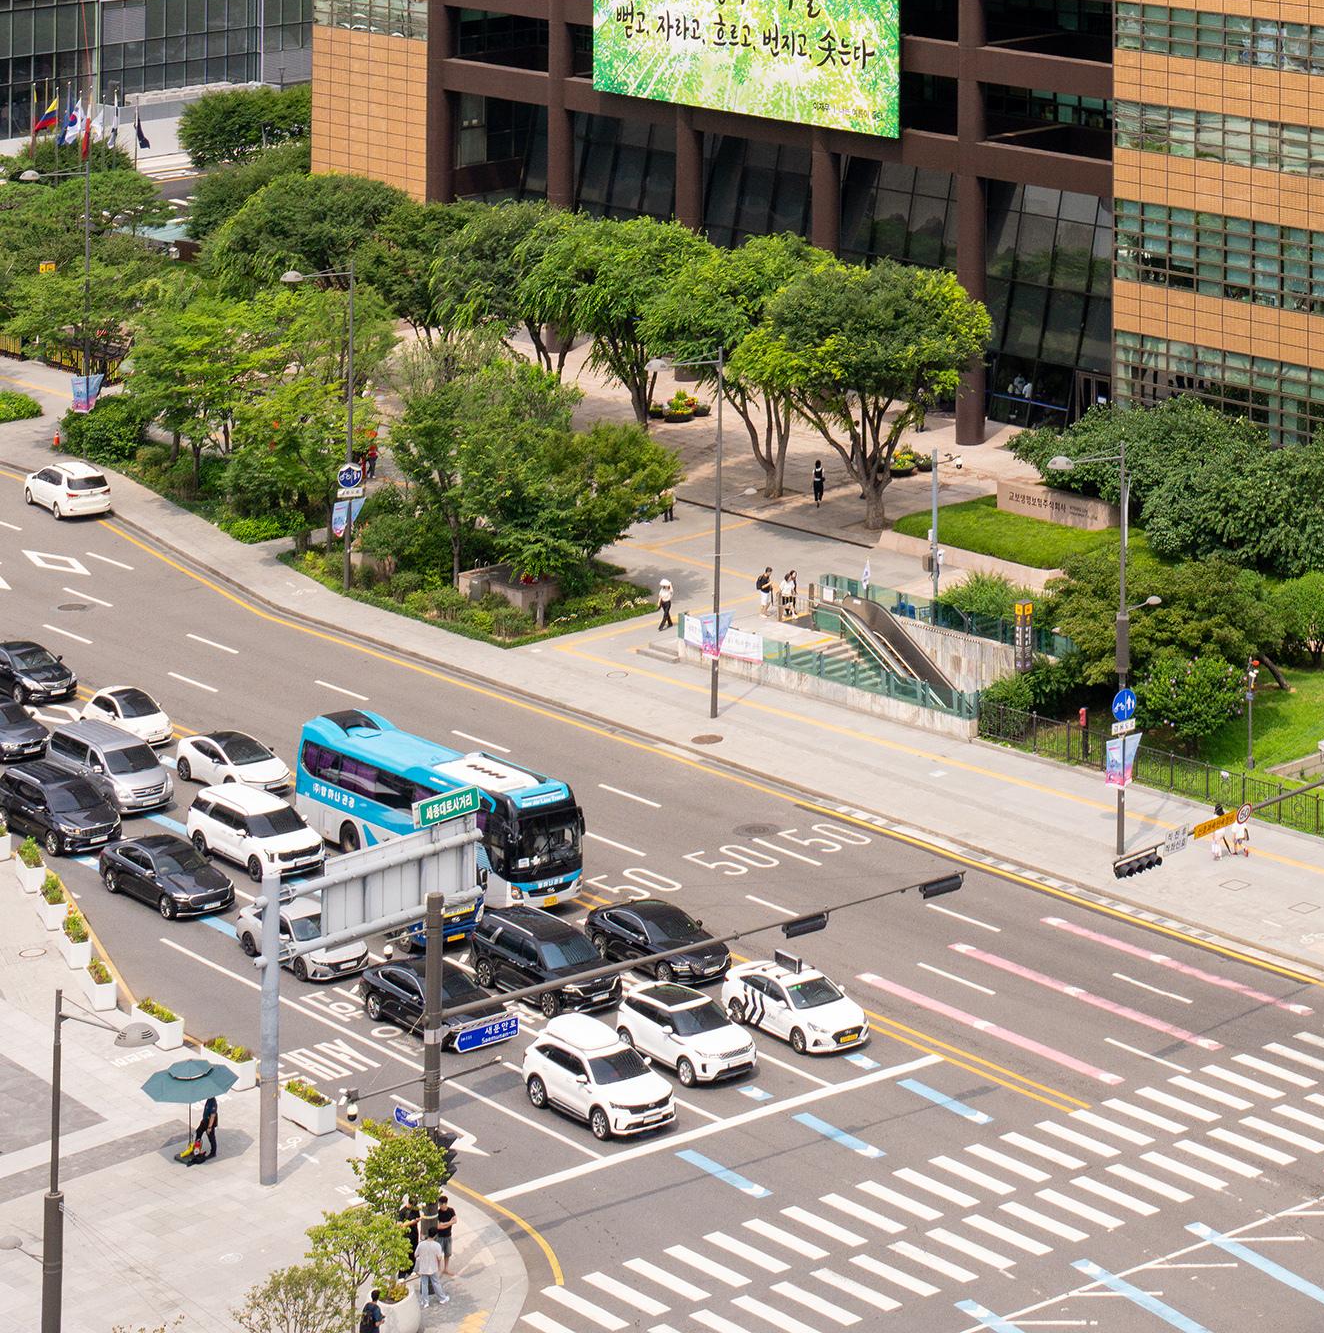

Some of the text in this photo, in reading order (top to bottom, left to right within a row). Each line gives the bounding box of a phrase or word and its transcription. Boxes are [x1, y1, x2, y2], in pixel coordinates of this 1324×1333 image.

[616, 0, 875, 70] 뻗고, 자라고, 흐르고, 번지고, 솟는다
[1009, 491, 1067, 512] 교보생명보험주식회사
[425, 793, 473, 820] 세종대로사거리
[1240, 807, 1249, 820] 50
[777, 823, 873, 853] 50
[682, 844, 780, 876] 50
[586, 867, 683, 901] 50
[481, 1030, 517, 1044] Saemunan-ro
[484, 1019, 517, 1035] 새문안로
